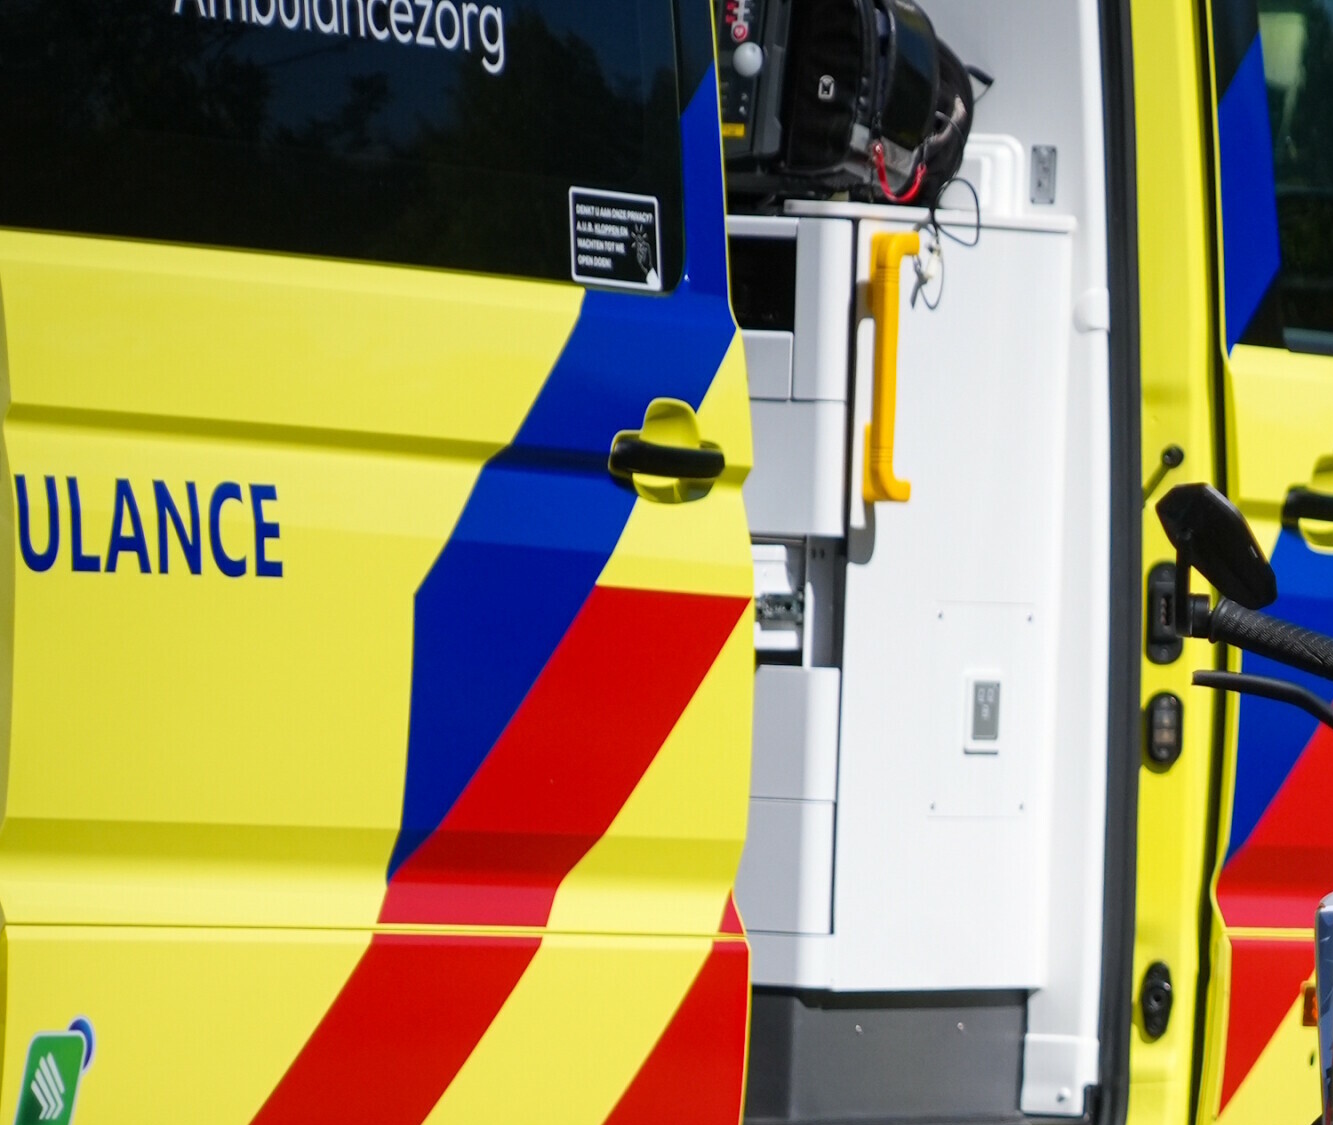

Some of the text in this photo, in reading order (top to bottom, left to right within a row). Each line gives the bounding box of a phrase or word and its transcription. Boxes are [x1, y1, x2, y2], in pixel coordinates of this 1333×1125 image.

[173, 0, 505, 73] uancezorg
[577, 254, 593, 267] OPEN
[14, 473, 284, 578] ULANCE
